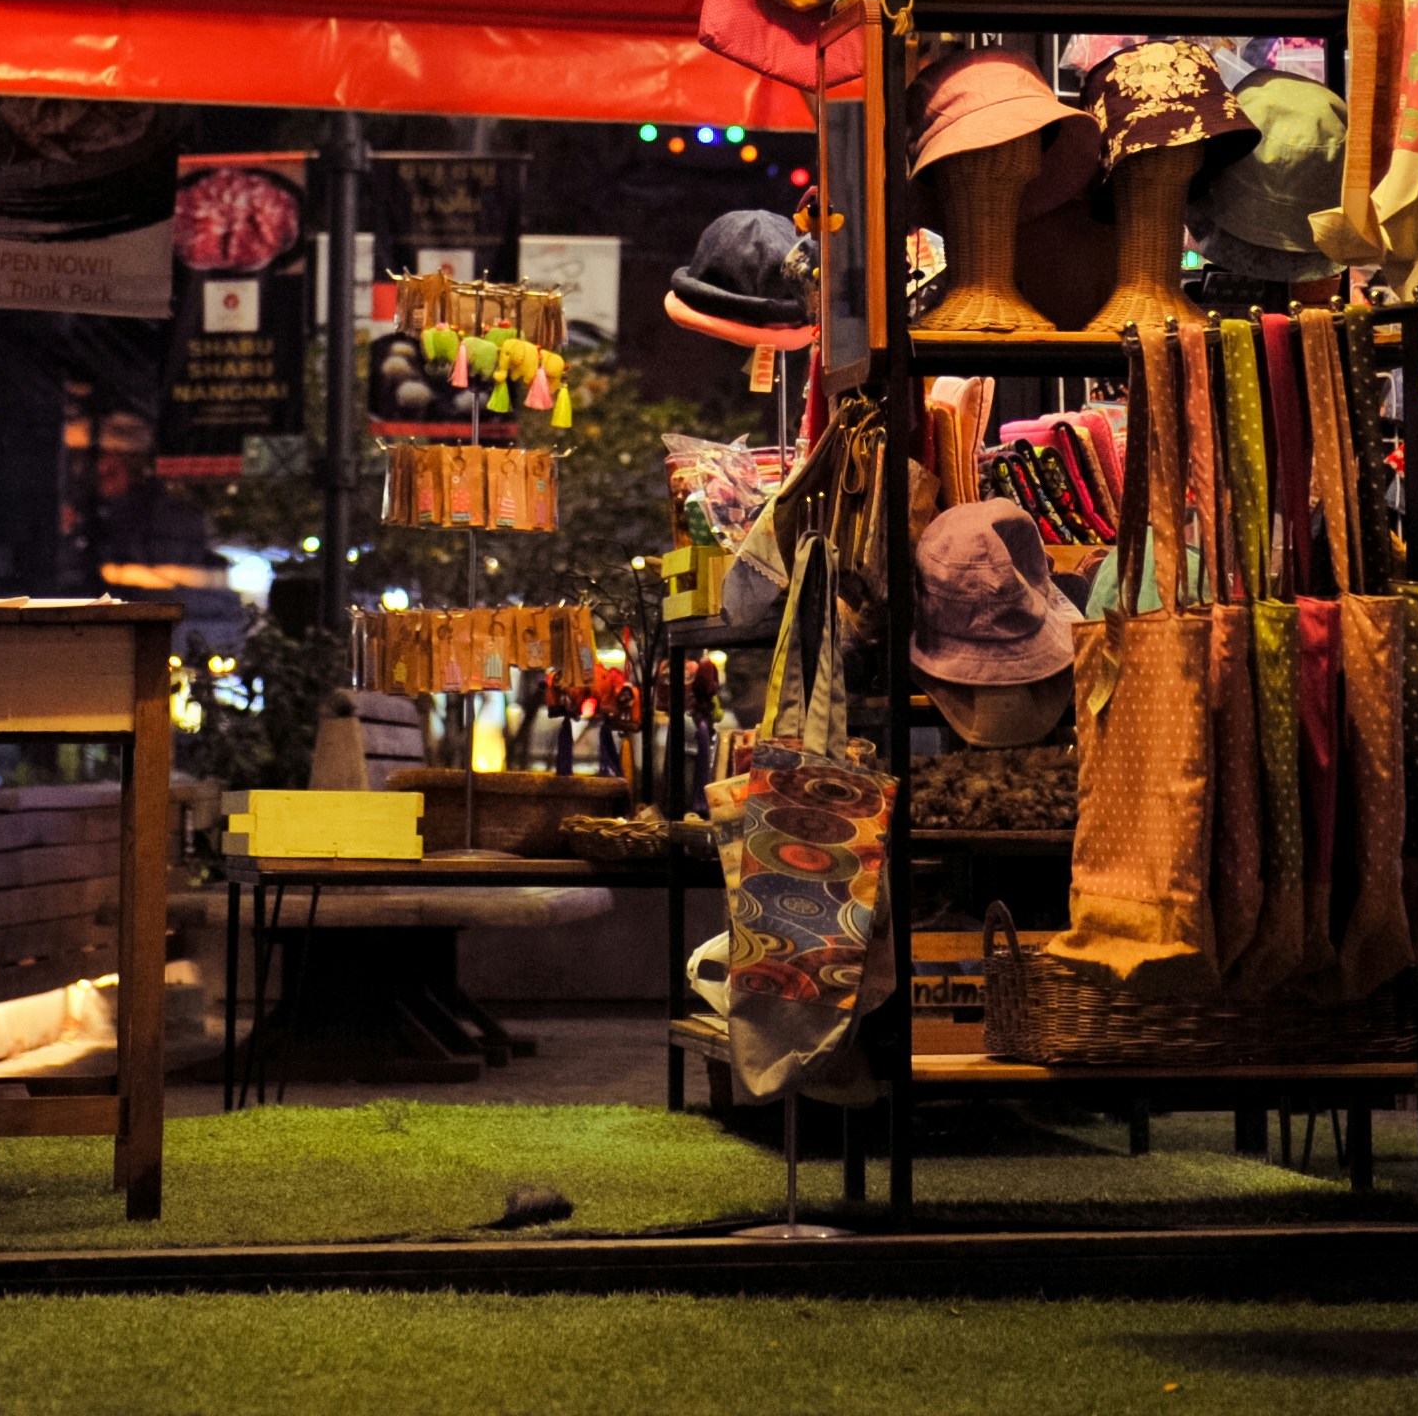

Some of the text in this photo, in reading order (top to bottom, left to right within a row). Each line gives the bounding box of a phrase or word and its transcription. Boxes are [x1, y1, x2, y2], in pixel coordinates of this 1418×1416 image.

[9, 279, 60, 300] Think
[69, 284, 111, 303] Park
[188, 338, 275, 357] SHABU
[188, 360, 275, 378] SHABU
